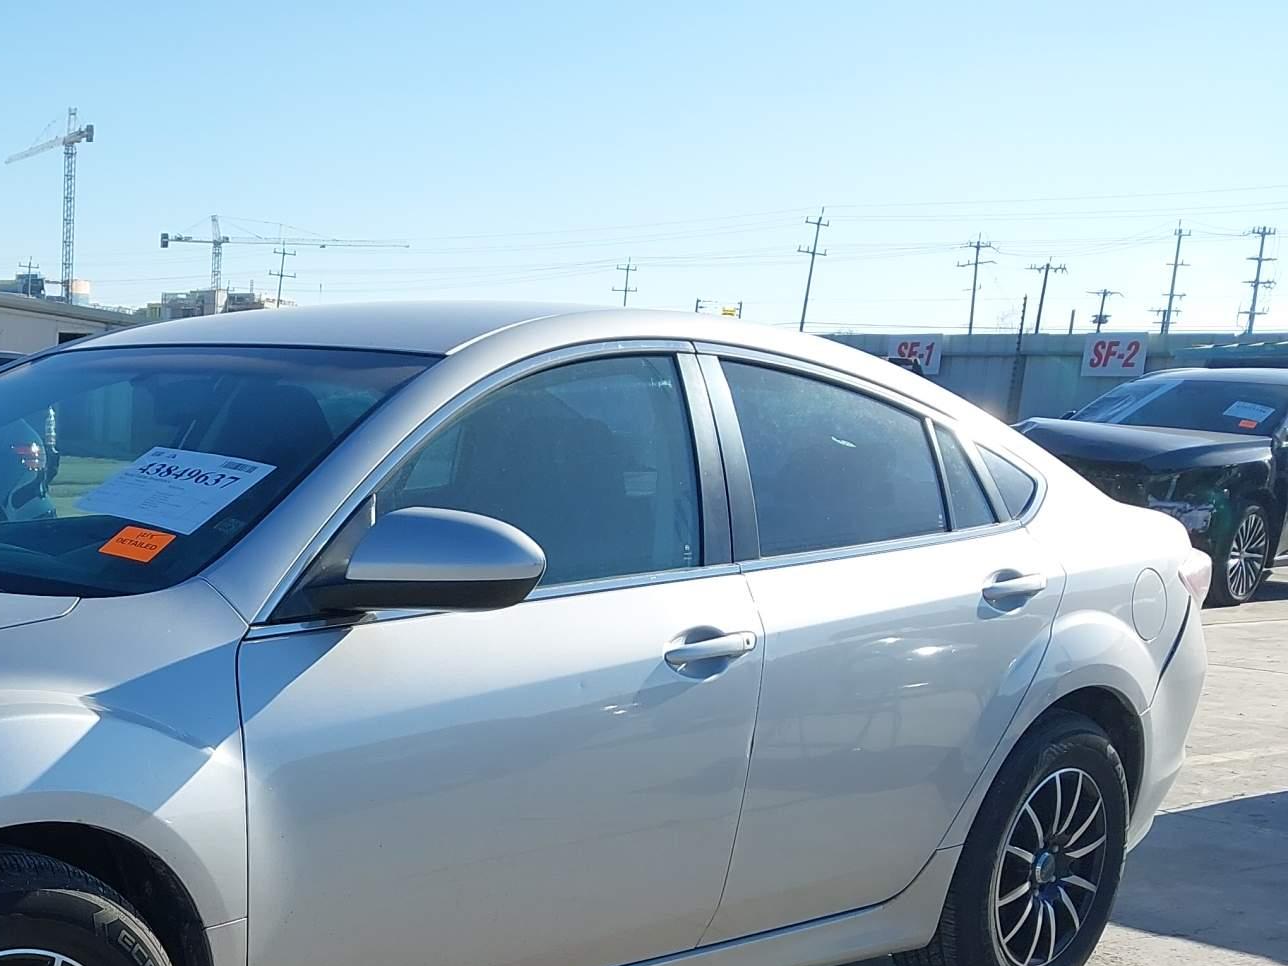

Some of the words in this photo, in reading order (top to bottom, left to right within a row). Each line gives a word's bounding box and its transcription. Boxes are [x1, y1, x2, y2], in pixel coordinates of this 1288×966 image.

[1089, 340, 1141, 368] SF-2
[137, 462, 241, 489] 43849637
[115, 537, 158, 551] DETAILED
